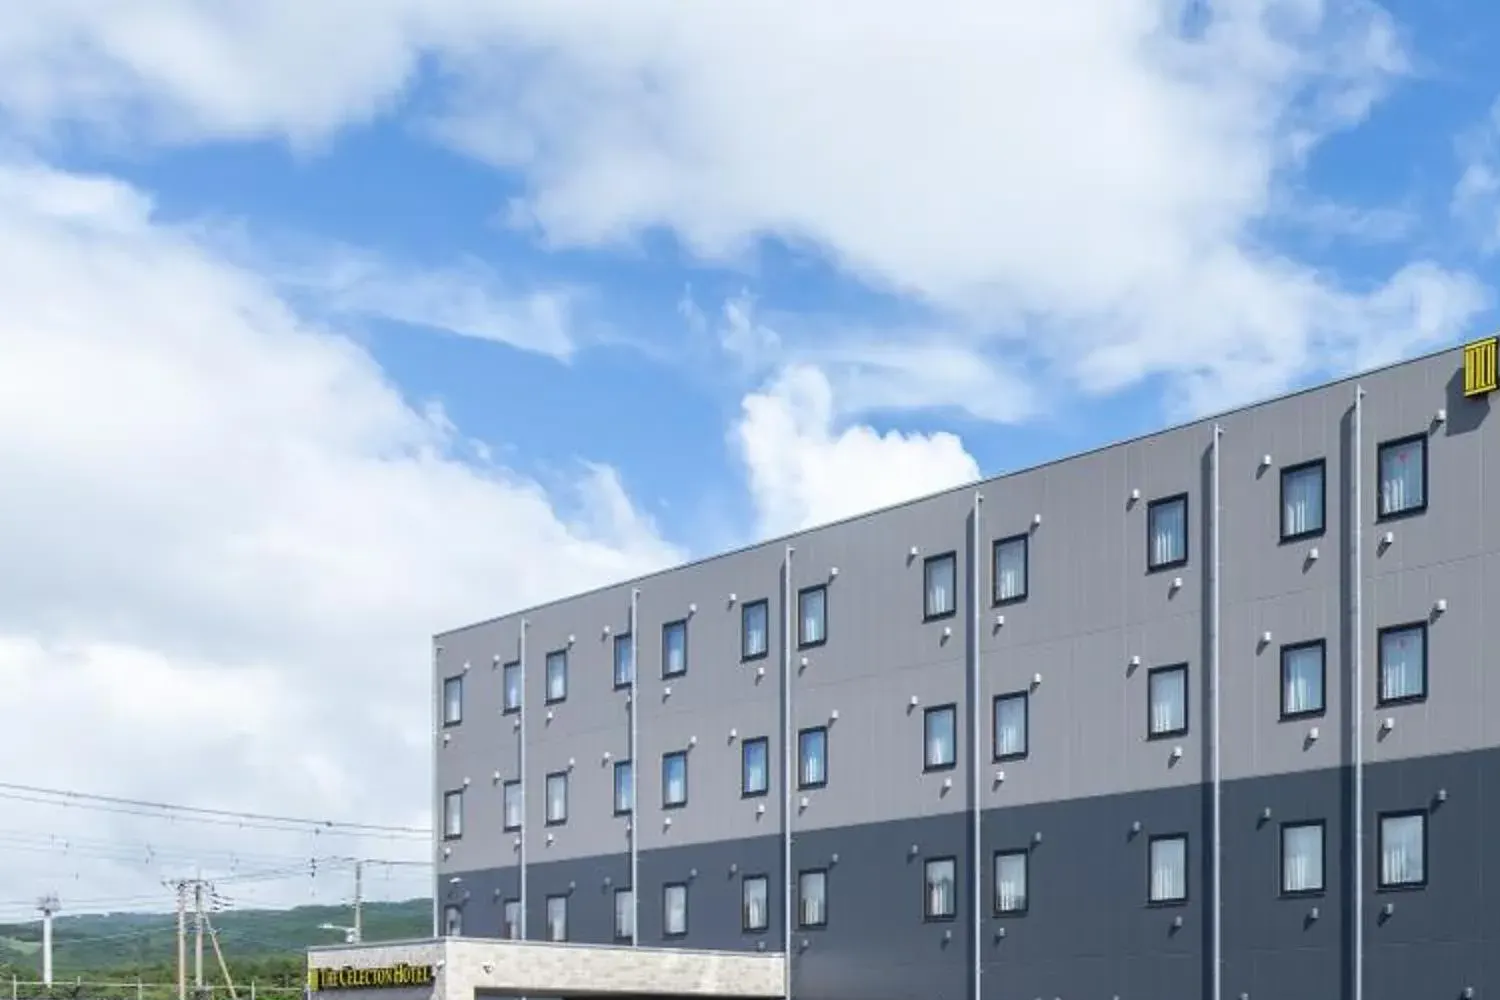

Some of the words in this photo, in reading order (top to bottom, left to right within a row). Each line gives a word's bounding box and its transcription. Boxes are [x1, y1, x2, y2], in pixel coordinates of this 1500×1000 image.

[320, 968, 339, 987] THE
[339, 966, 393, 985] CELECTON
[393, 962, 429, 985] HOTEL
